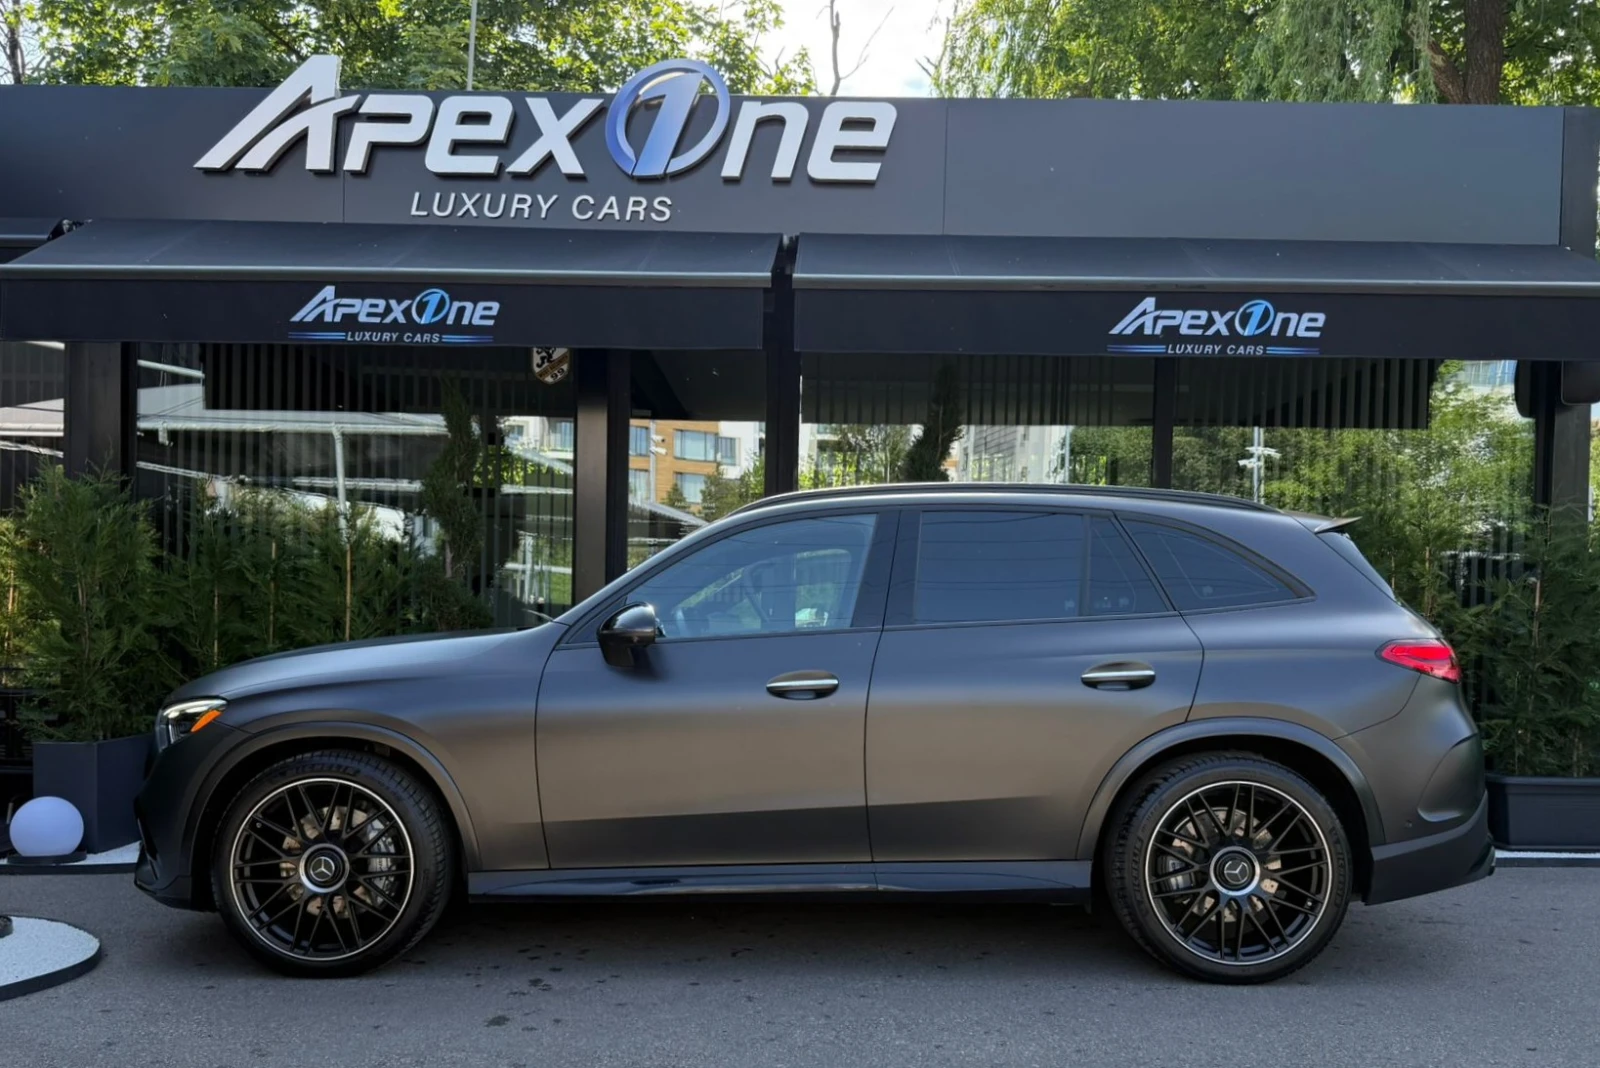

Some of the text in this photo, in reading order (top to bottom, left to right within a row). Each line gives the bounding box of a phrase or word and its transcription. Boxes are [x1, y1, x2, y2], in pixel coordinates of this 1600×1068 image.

[410, 191, 673, 222] LUXURY CARS
[346, 331, 441, 344] LUXURY CARS
[1167, 343, 1264, 355] LUXURY CARS
